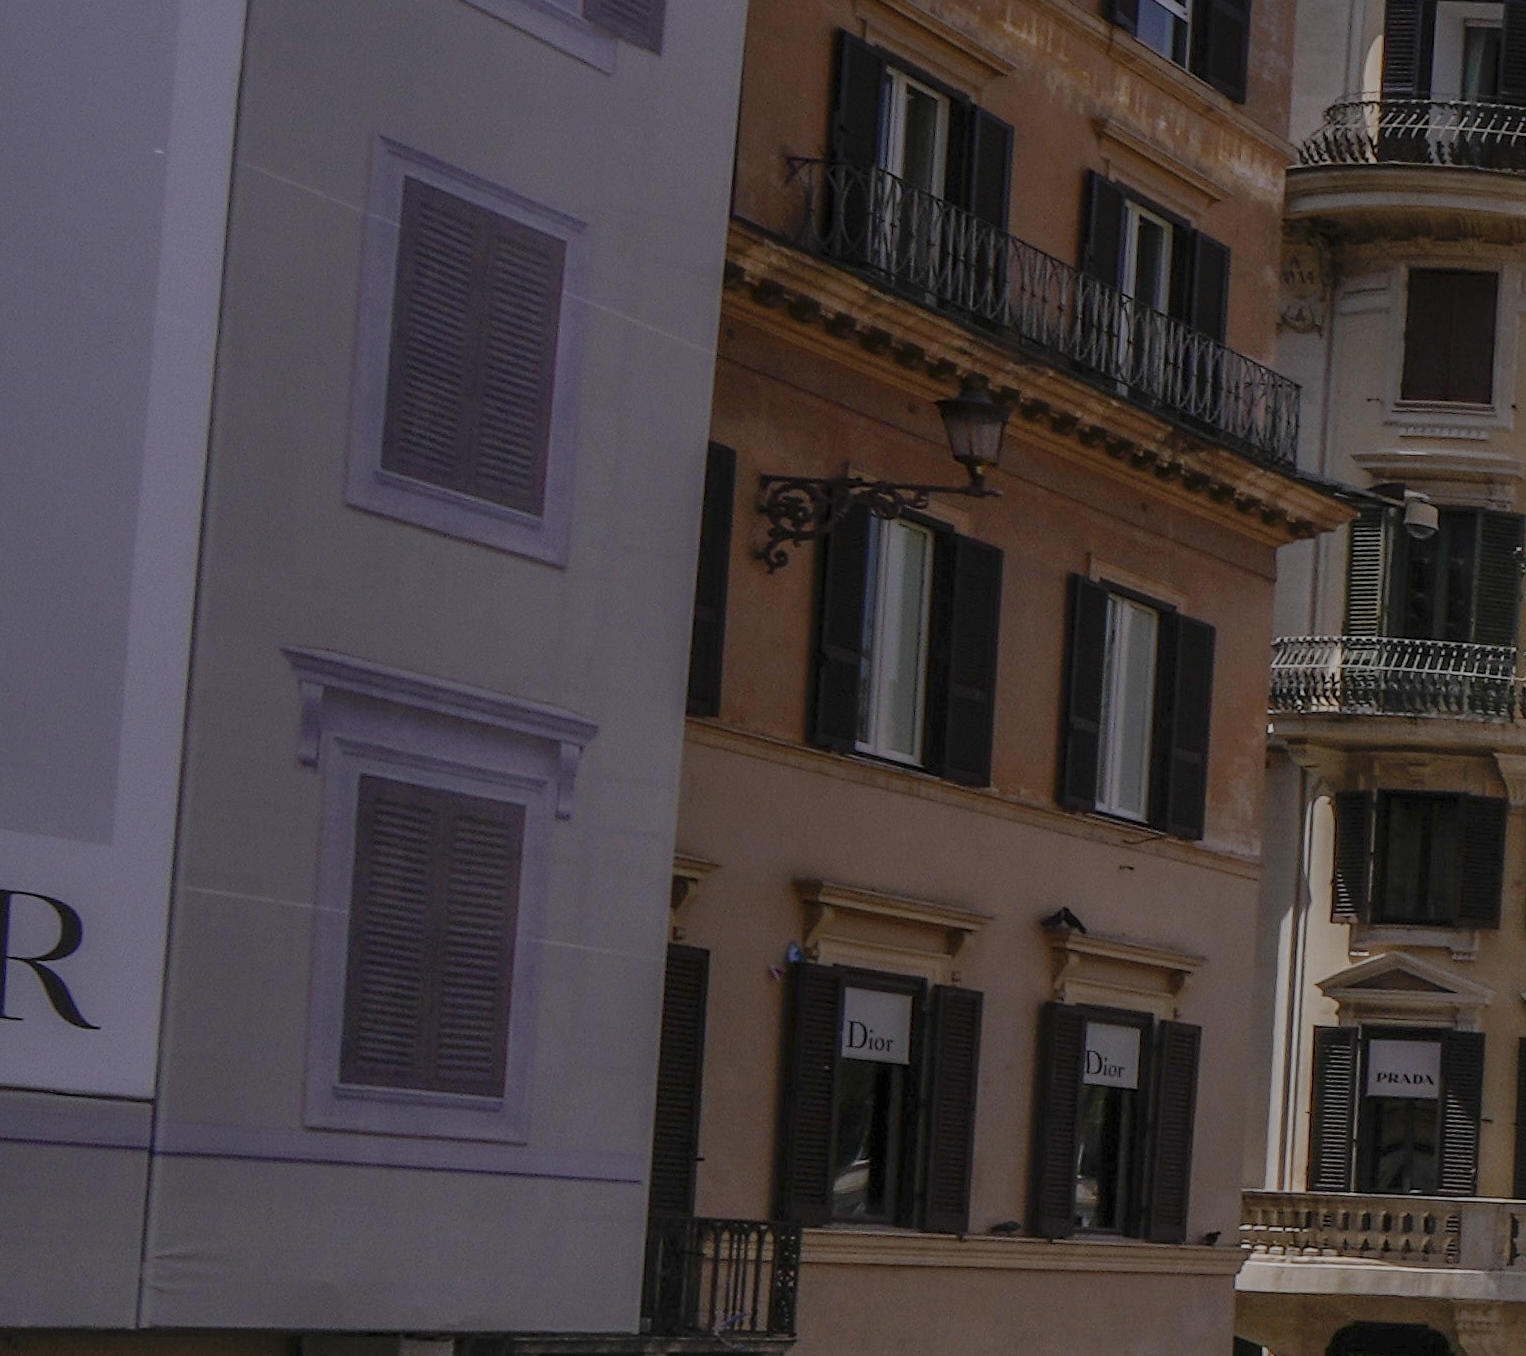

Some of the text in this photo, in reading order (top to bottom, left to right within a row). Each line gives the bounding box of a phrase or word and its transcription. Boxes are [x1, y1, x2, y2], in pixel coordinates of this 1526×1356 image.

[847, 1020, 894, 1052] Dior
[1085, 1050, 1125, 1078] Dior
[1377, 1072, 1434, 1085] PRADA
